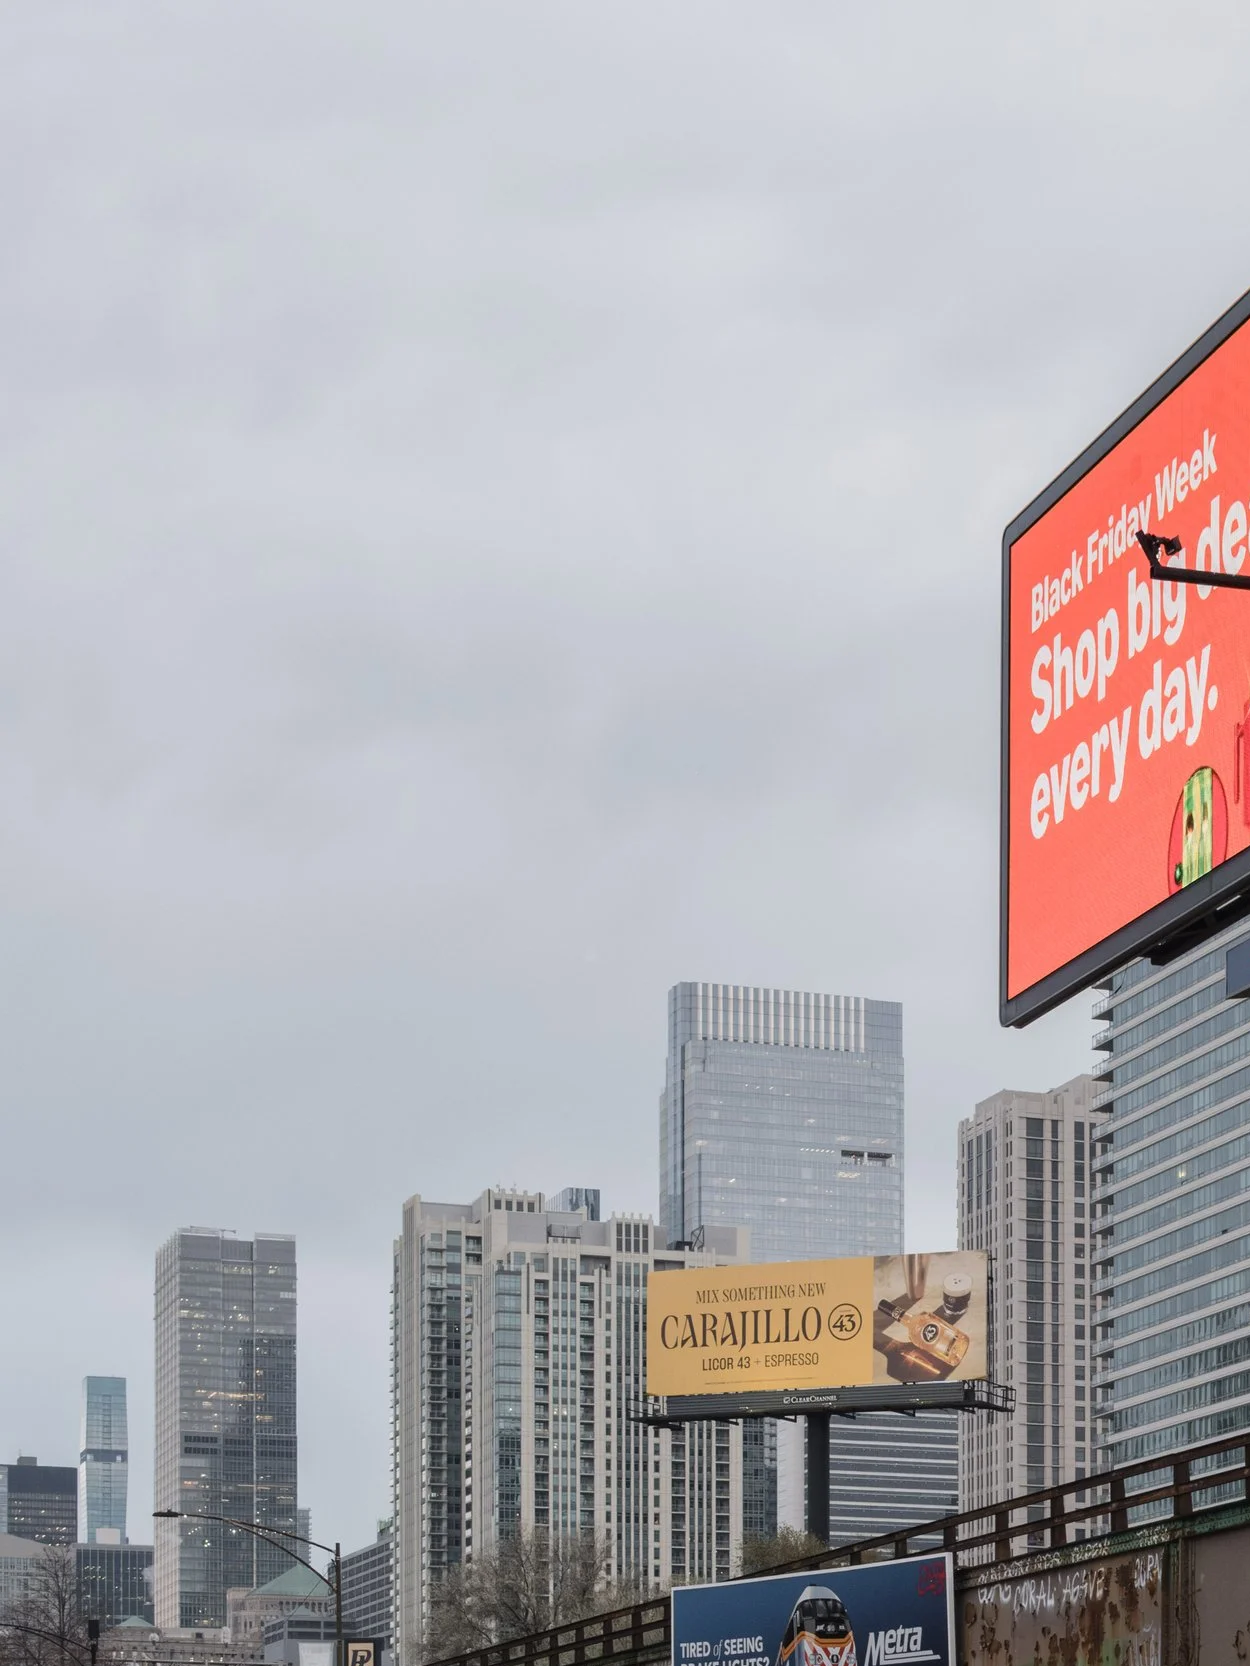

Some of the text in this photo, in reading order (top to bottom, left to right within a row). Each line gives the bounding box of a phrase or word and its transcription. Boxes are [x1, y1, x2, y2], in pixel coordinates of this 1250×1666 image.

[1031, 428, 1217, 633] Black Friday Week
[1031, 605, 1120, 735] Shop
[1128, 548, 1188, 661] big
[1030, 644, 1218, 840] every day.
[696, 1282, 827, 1304] MIX SOMETHING NEW
[661, 1306, 856, 1352] CARAJILLO 43
[702, 1357, 735, 1372] LICOR
[737, 1356, 751, 1370] 43
[765, 1352, 819, 1368] ESPRESSO
[680, 1636, 763, 1660] TIRED of SEEING
[864, 1625, 923, 1666] Metra
